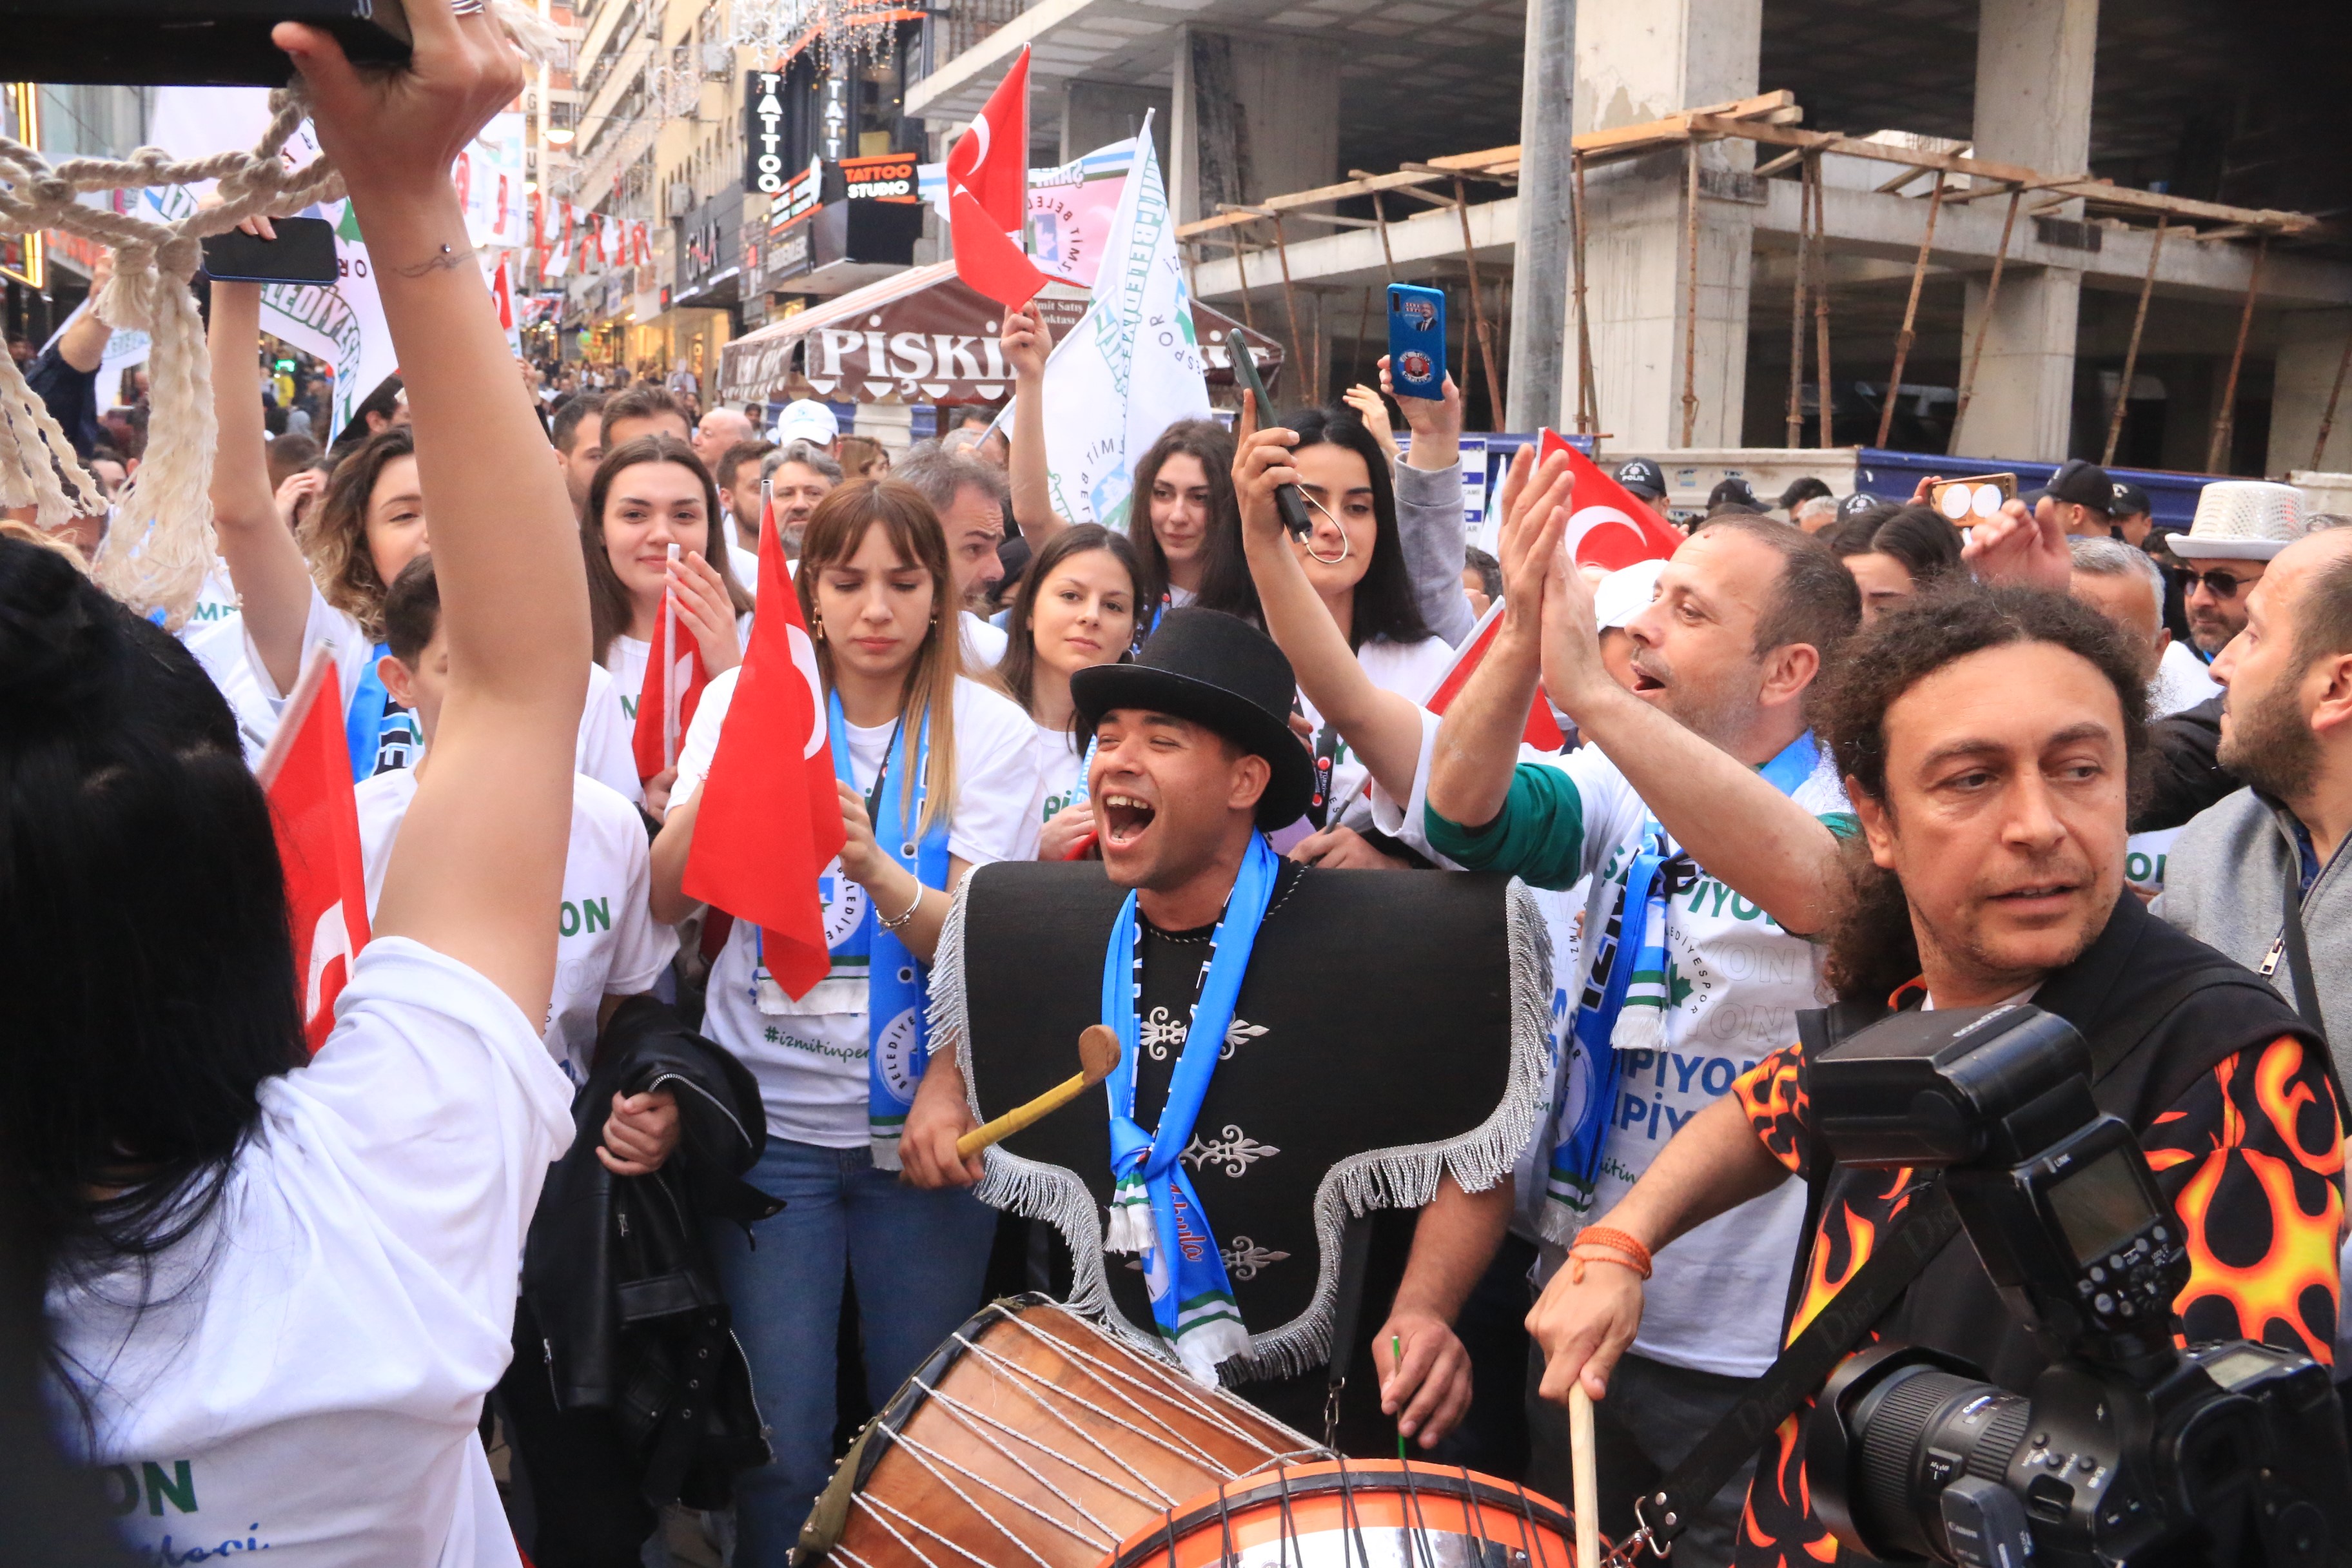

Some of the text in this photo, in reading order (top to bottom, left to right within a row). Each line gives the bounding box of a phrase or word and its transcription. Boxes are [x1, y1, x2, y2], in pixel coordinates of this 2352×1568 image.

[756, 74, 783, 193] TATTOO
[825, 80, 845, 162] TATT
[844, 164, 912, 183] TATTOO
[847, 180, 910, 199] STUDIO
[821, 315, 1017, 396] PİŞKİ
[1665, 926, 1712, 1015] EDİYESPOR
